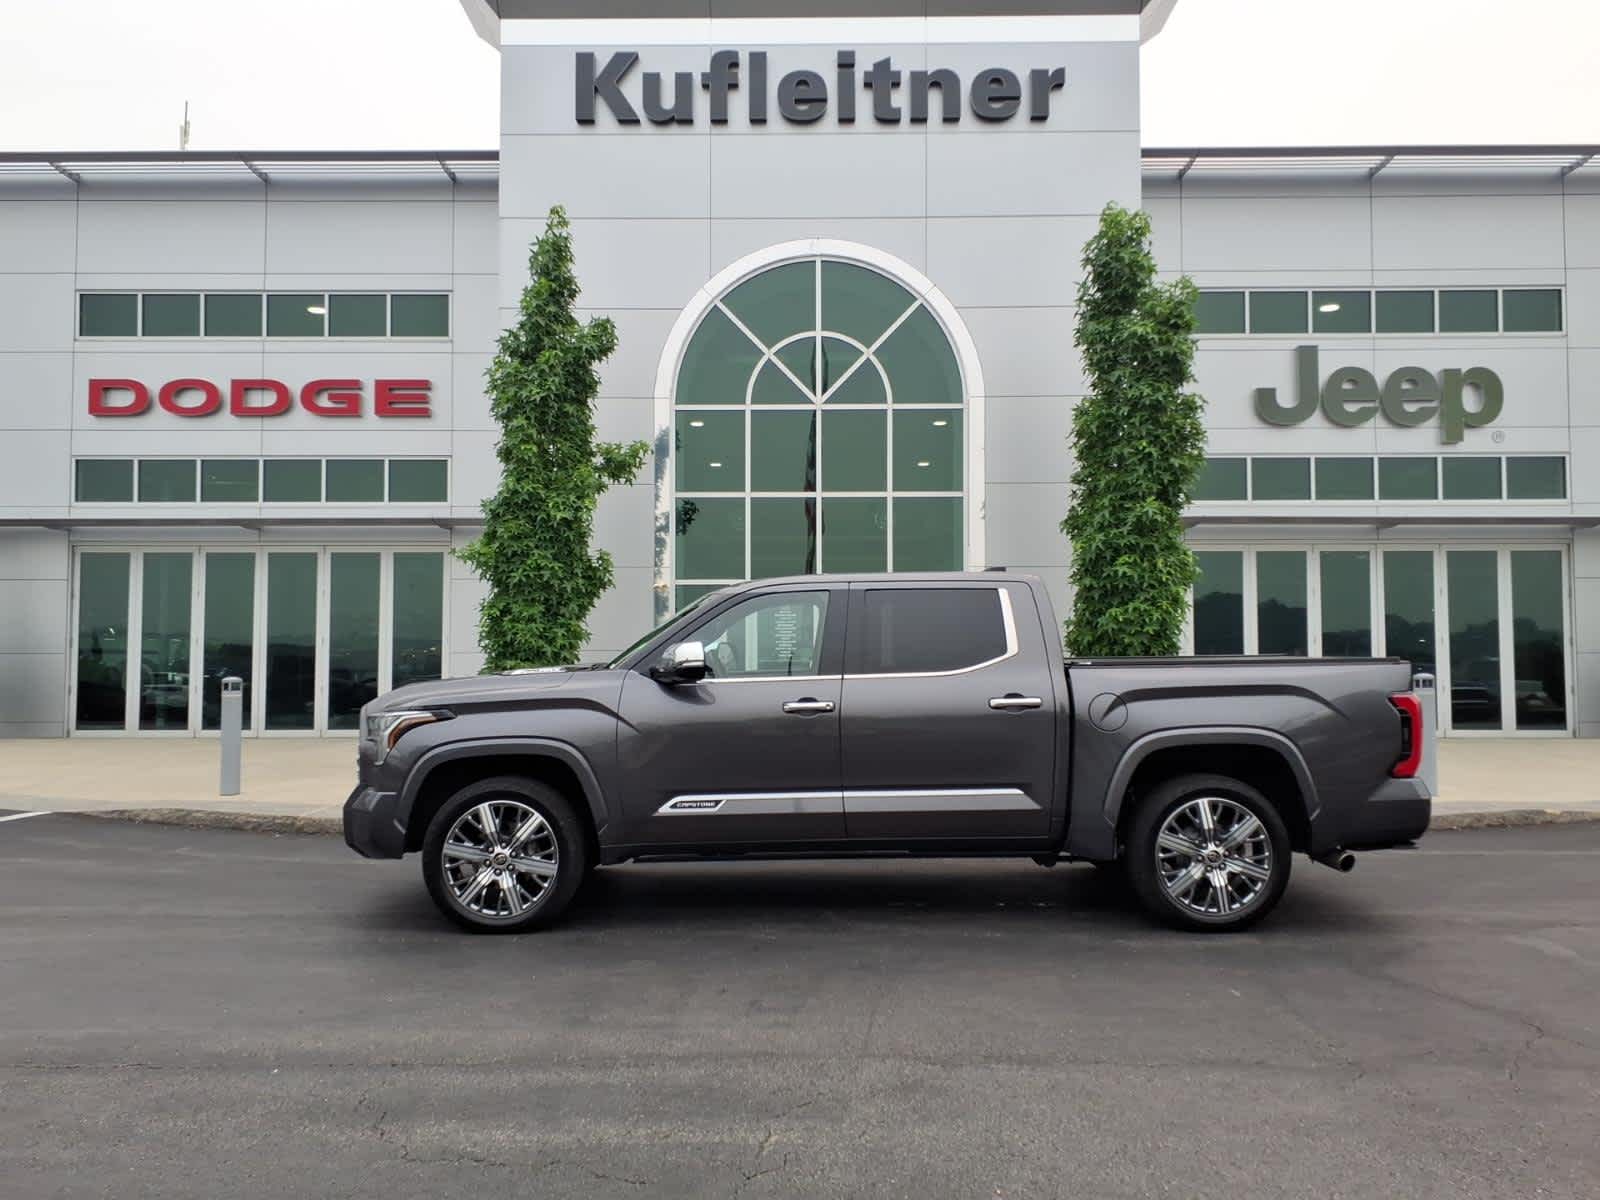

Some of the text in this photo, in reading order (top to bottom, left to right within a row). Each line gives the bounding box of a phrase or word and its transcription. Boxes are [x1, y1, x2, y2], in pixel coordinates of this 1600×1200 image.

[575, 50, 1065, 125] Kufleitner
[88, 378, 433, 417] DODGE
[1253, 345, 1504, 445] Jeep
